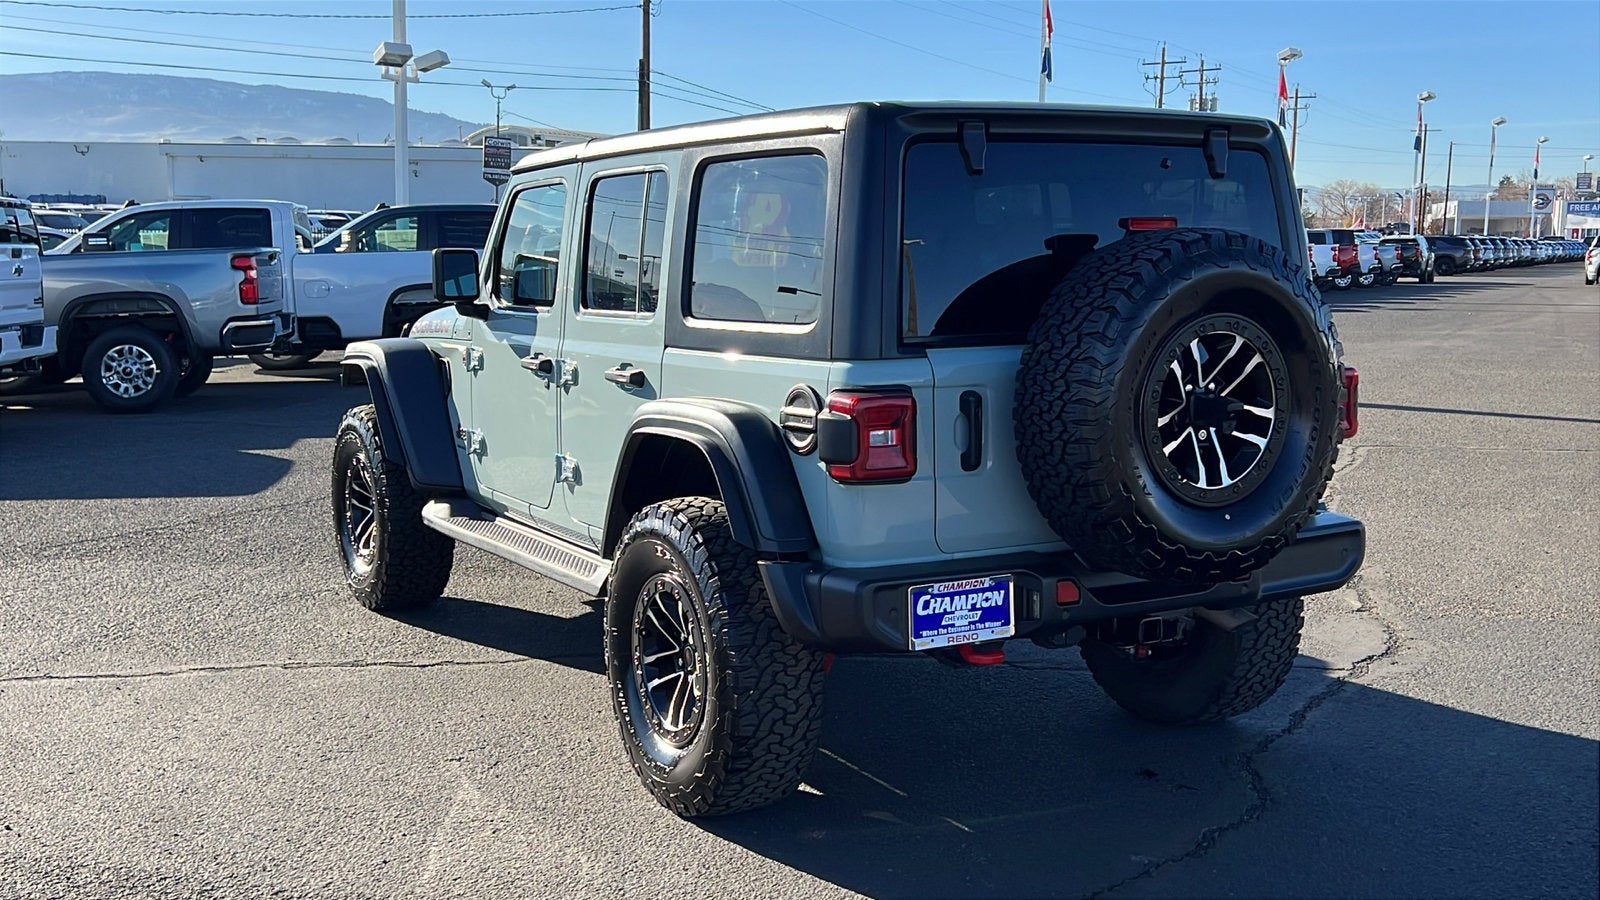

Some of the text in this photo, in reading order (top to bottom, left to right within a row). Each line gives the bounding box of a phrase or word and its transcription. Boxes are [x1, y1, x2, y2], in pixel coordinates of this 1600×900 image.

[1570, 203, 1590, 212] FREE
[937, 579, 986, 593] CHAMPION
[916, 590, 1005, 616] CHAMPION
[944, 612, 979, 623] CHEVROLET
[938, 627, 947, 635] The
[947, 625, 971, 634] Customer
[947, 632, 979, 644] RENO
